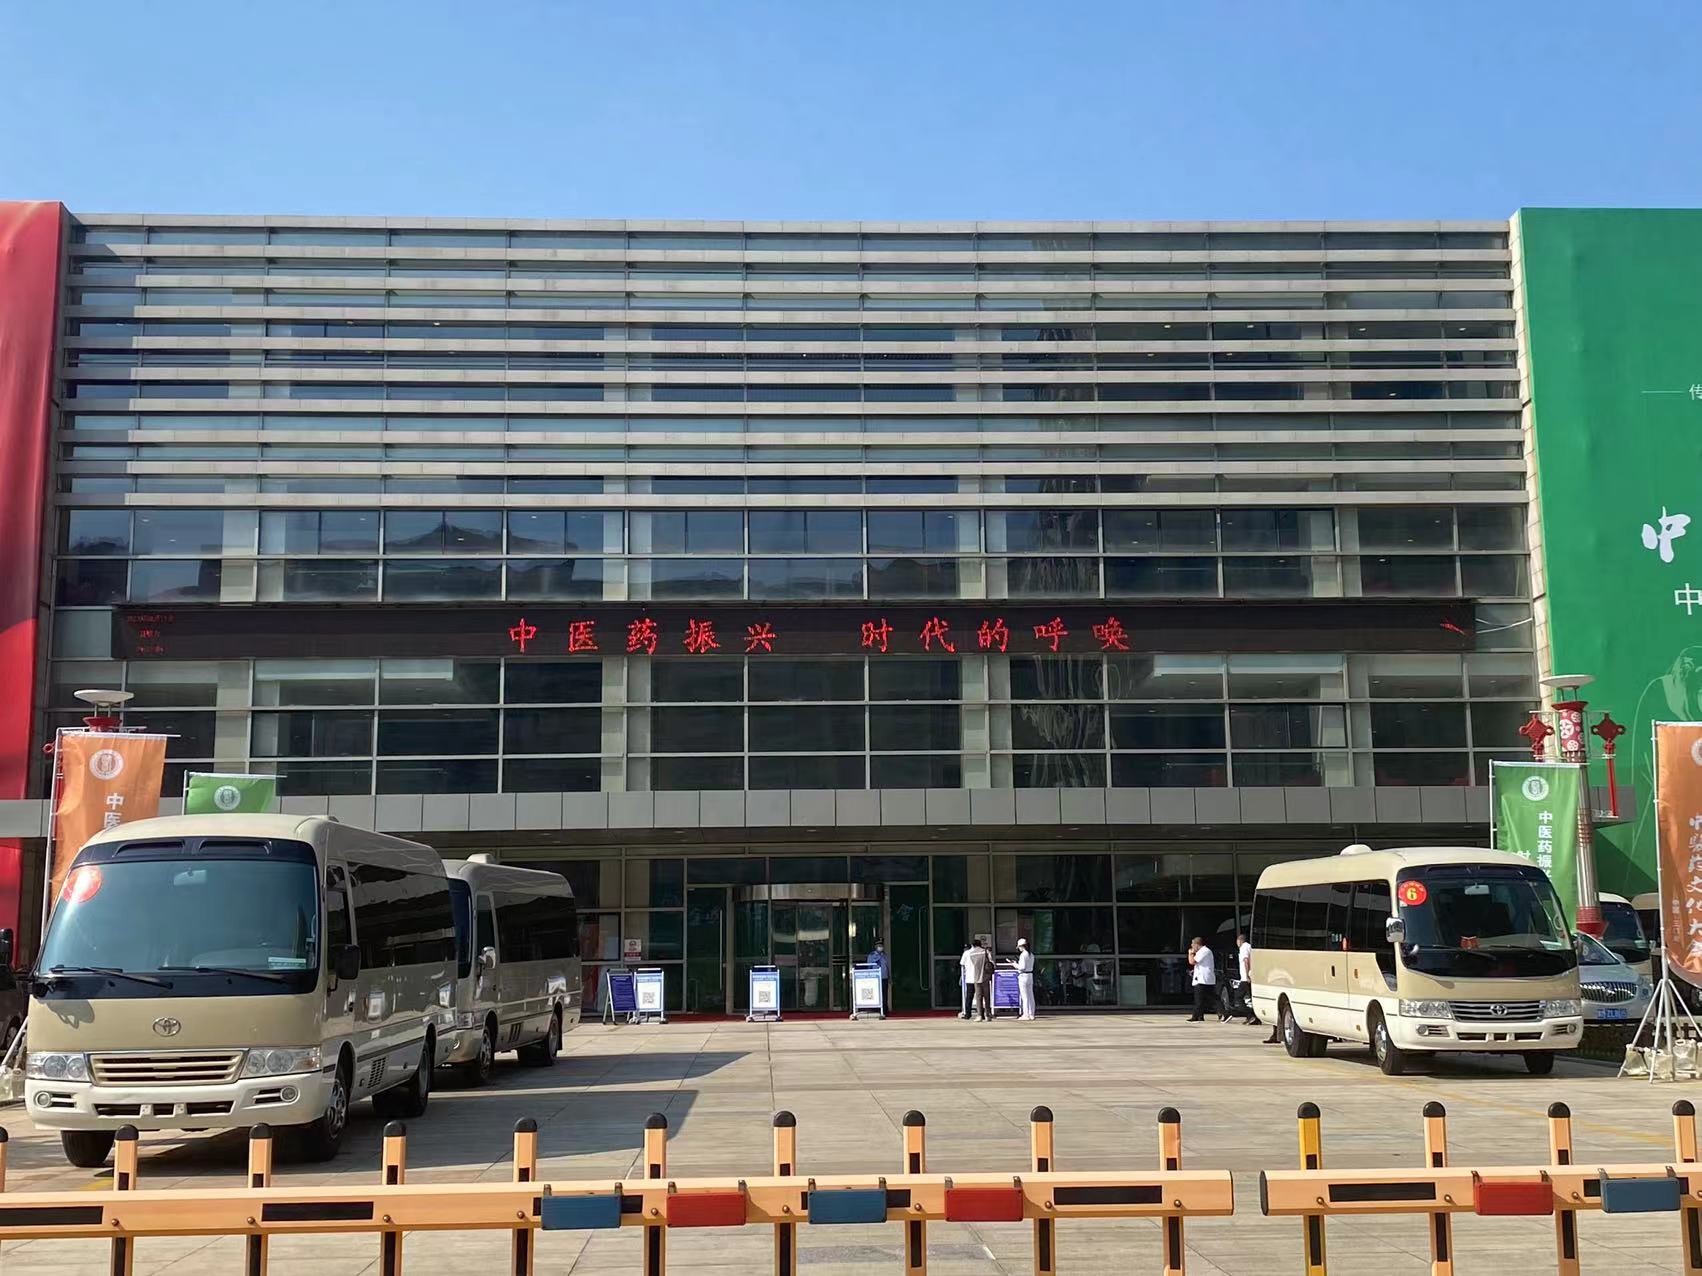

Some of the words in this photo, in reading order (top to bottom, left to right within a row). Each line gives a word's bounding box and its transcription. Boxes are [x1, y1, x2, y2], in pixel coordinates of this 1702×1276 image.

[1674, 582, 1702, 615] 中
[507, 618, 776, 654] 中医药振兴
[861, 615, 1127, 653] 时代的呼唤
[1406, 887, 1418, 901] 6
